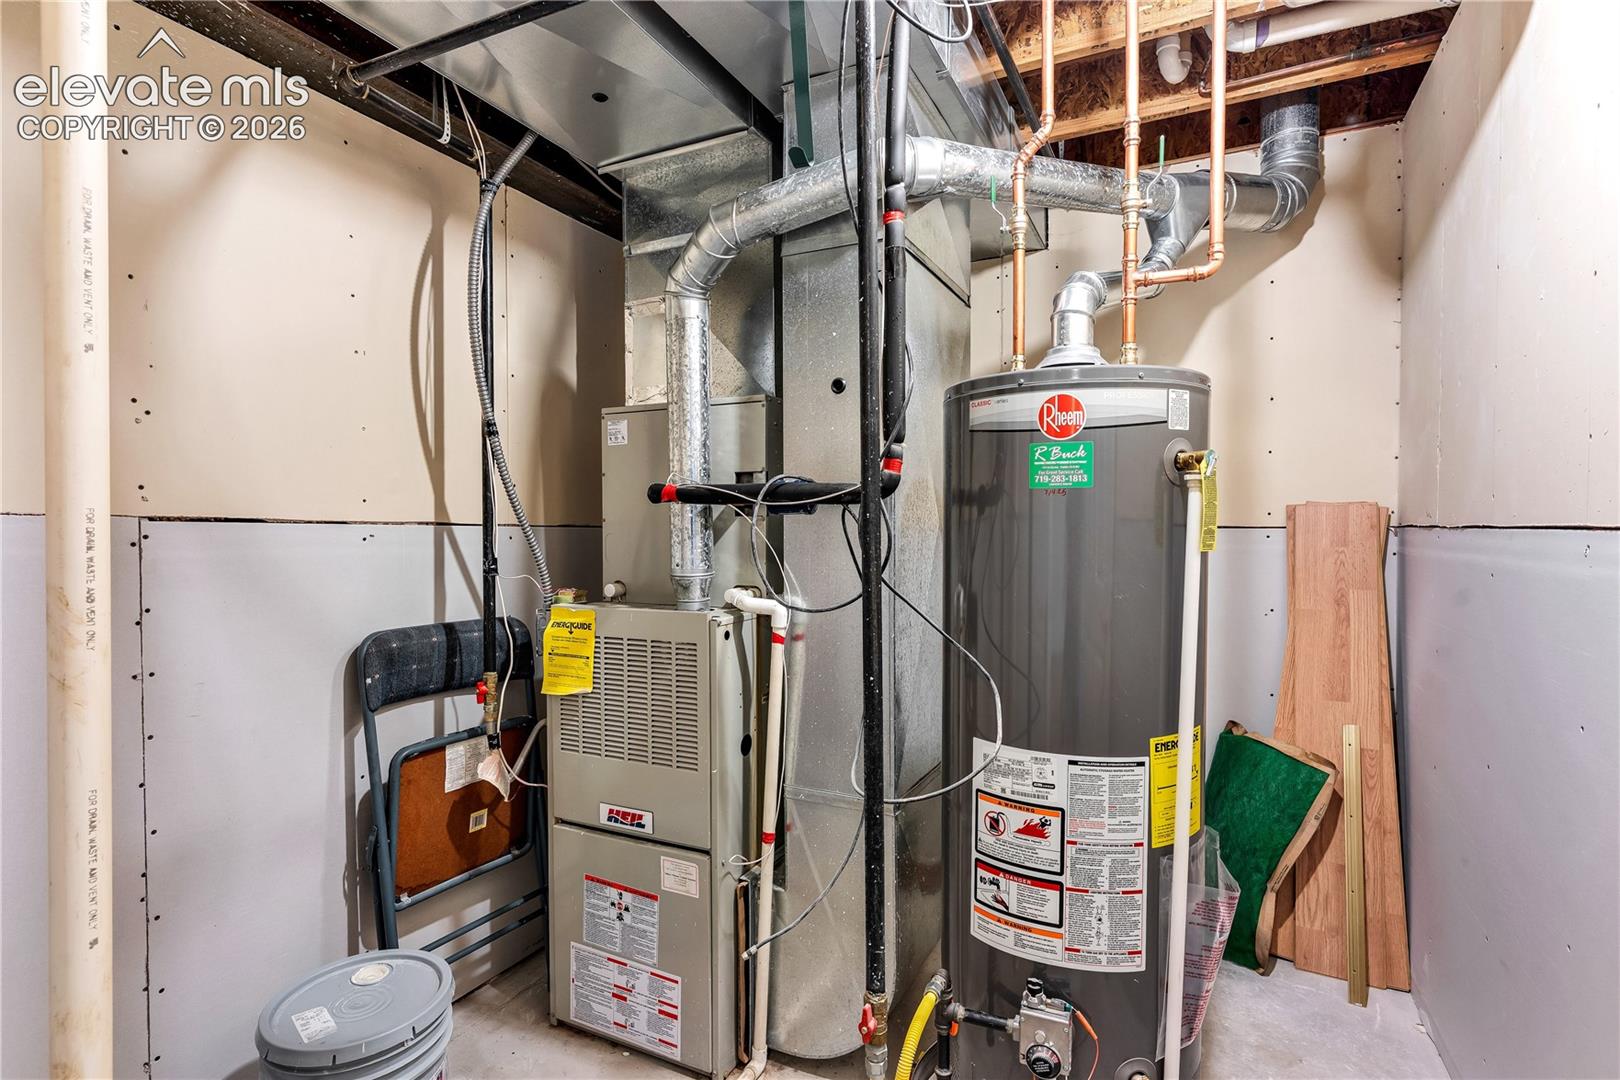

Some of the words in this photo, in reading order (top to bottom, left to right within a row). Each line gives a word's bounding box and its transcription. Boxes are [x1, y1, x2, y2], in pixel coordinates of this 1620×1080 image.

[971, 400, 992, 408] CLASSIC
[1043, 395, 1083, 432] Rheem
[1034, 445, 1047, 461] R
[1048, 444, 1087, 460] Buck
[1034, 474, 1088, 483] 719-283-1813
[86, 507, 96, 524] FOR
[86, 556, 96, 584] WASTE
[86, 630, 96, 651] ONLY
[88, 789, 98, 806] FOR
[1004, 802, 1035, 813] WARNING
[607, 808, 646, 829] HEIL
[88, 837, 98, 865] WASTE
[88, 867, 98, 884] AND
[1005, 873, 1032, 885] DANGER
[88, 885, 98, 906] VENT
[88, 909, 98, 929] ONLY
[1004, 919, 1032, 932] WARNING
